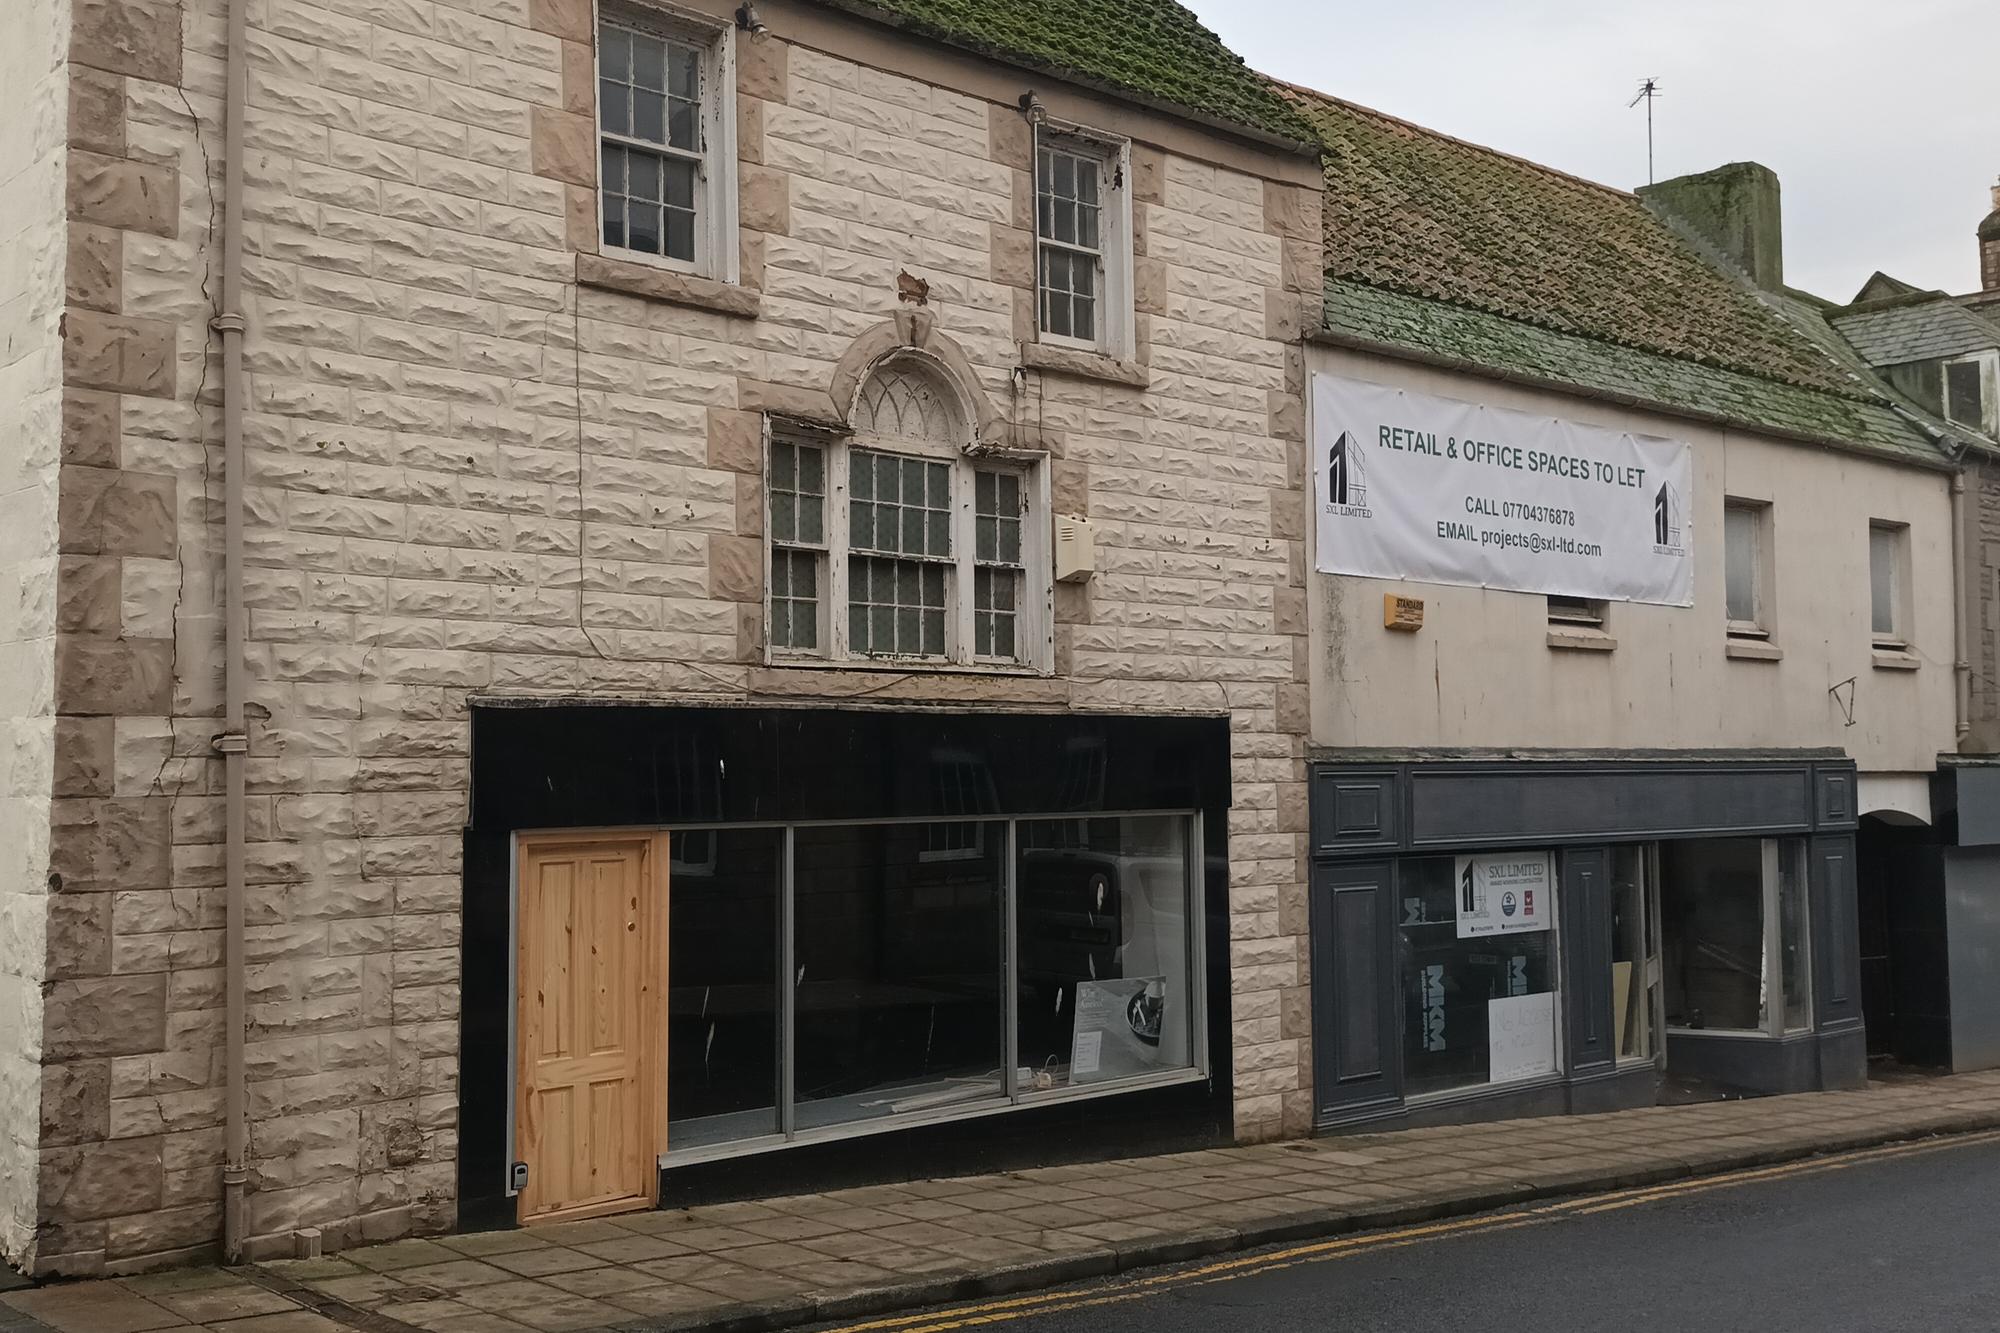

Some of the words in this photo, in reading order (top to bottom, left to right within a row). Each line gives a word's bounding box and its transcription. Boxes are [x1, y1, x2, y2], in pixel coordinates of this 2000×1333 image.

[1379, 425, 1442, 457] RETAIL
[1446, 436, 1458, 460] &
[1463, 439, 1523, 470] OFFICE
[1528, 450, 1590, 480] SPACES
[1594, 461, 1613, 484] TO
[1617, 466, 1646, 489] LET
[1325, 504, 1339, 515] SXL
[1340, 506, 1373, 519] LIMITED
[1465, 496, 1499, 517] CALL
[1502, 501, 1575, 527] 07704376878
[1437, 520, 1478, 542] EMAIL
[1481, 528, 1602, 557] projects@sxl-ltd.com
[1489, 864, 1507, 879] SXL
[1507, 863, 1544, 878] LIMITED
